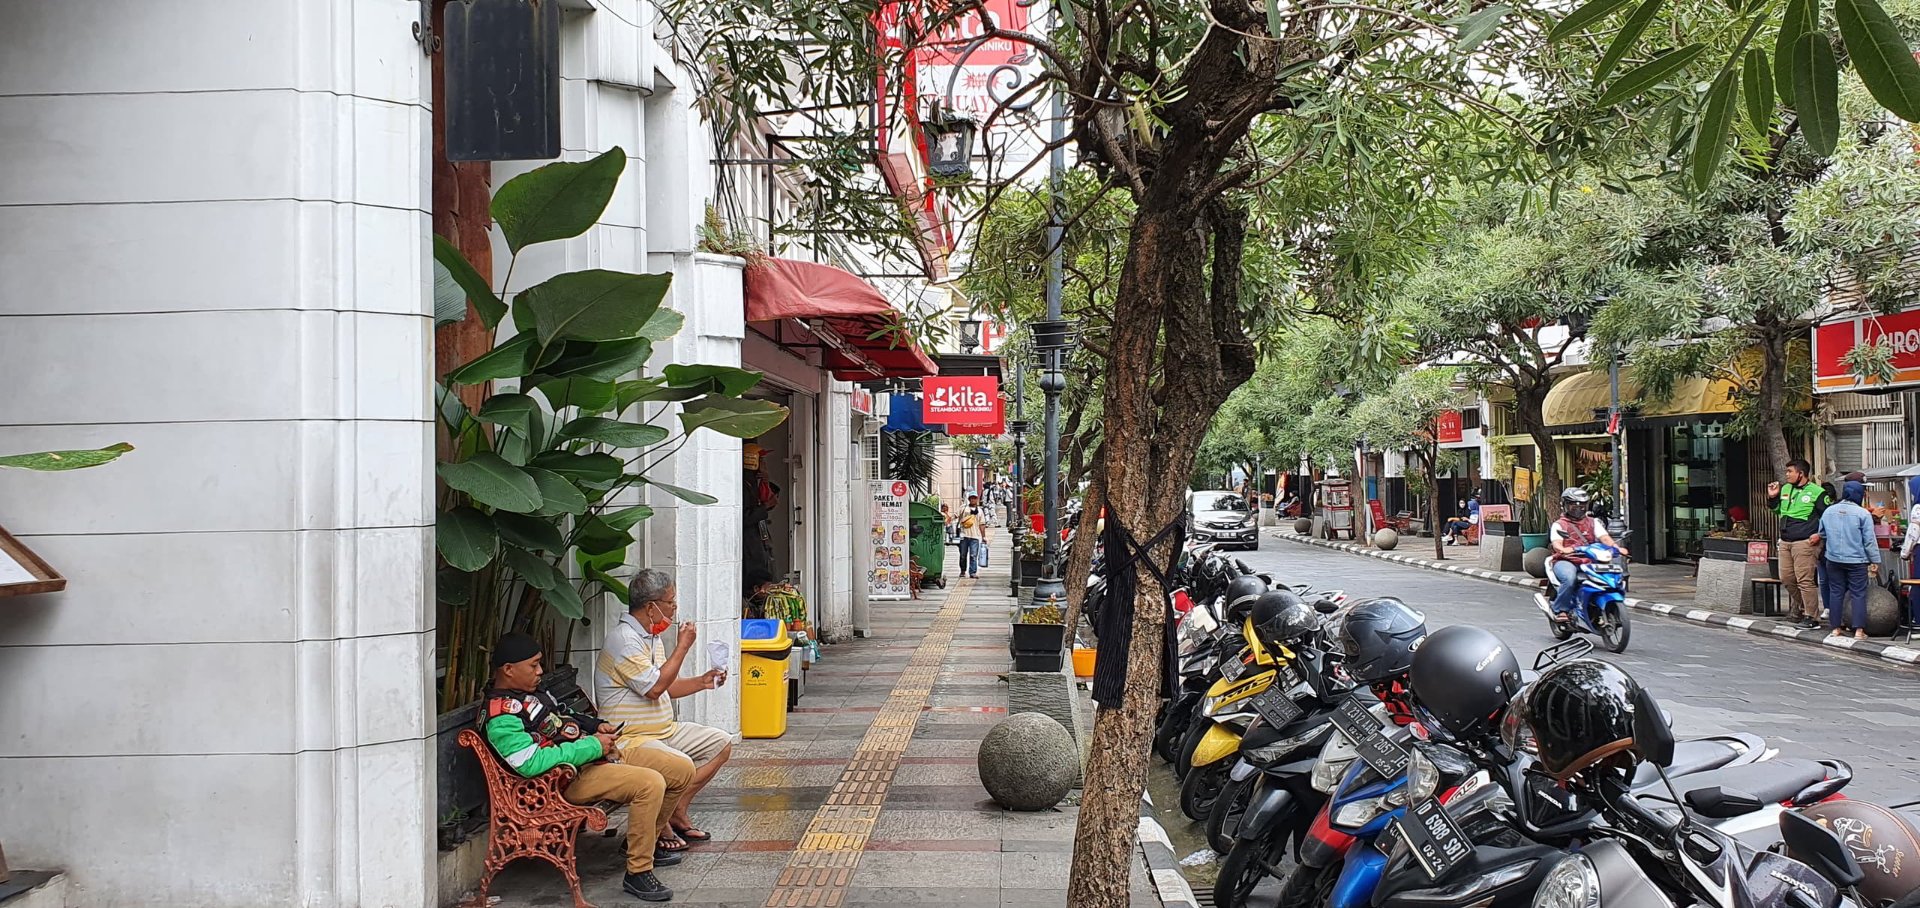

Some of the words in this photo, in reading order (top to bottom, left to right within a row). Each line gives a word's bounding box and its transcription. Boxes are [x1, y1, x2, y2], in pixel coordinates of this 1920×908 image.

[1347, 706, 1366, 724] 2312
[1366, 732, 1378, 742] D
[1373, 738, 1395, 756] 2057
[1537, 789, 1563, 809] HONDA
[1417, 802, 1432, 815] D
[1425, 813, 1451, 840] 6988
[1769, 869, 1817, 899] HONDA
